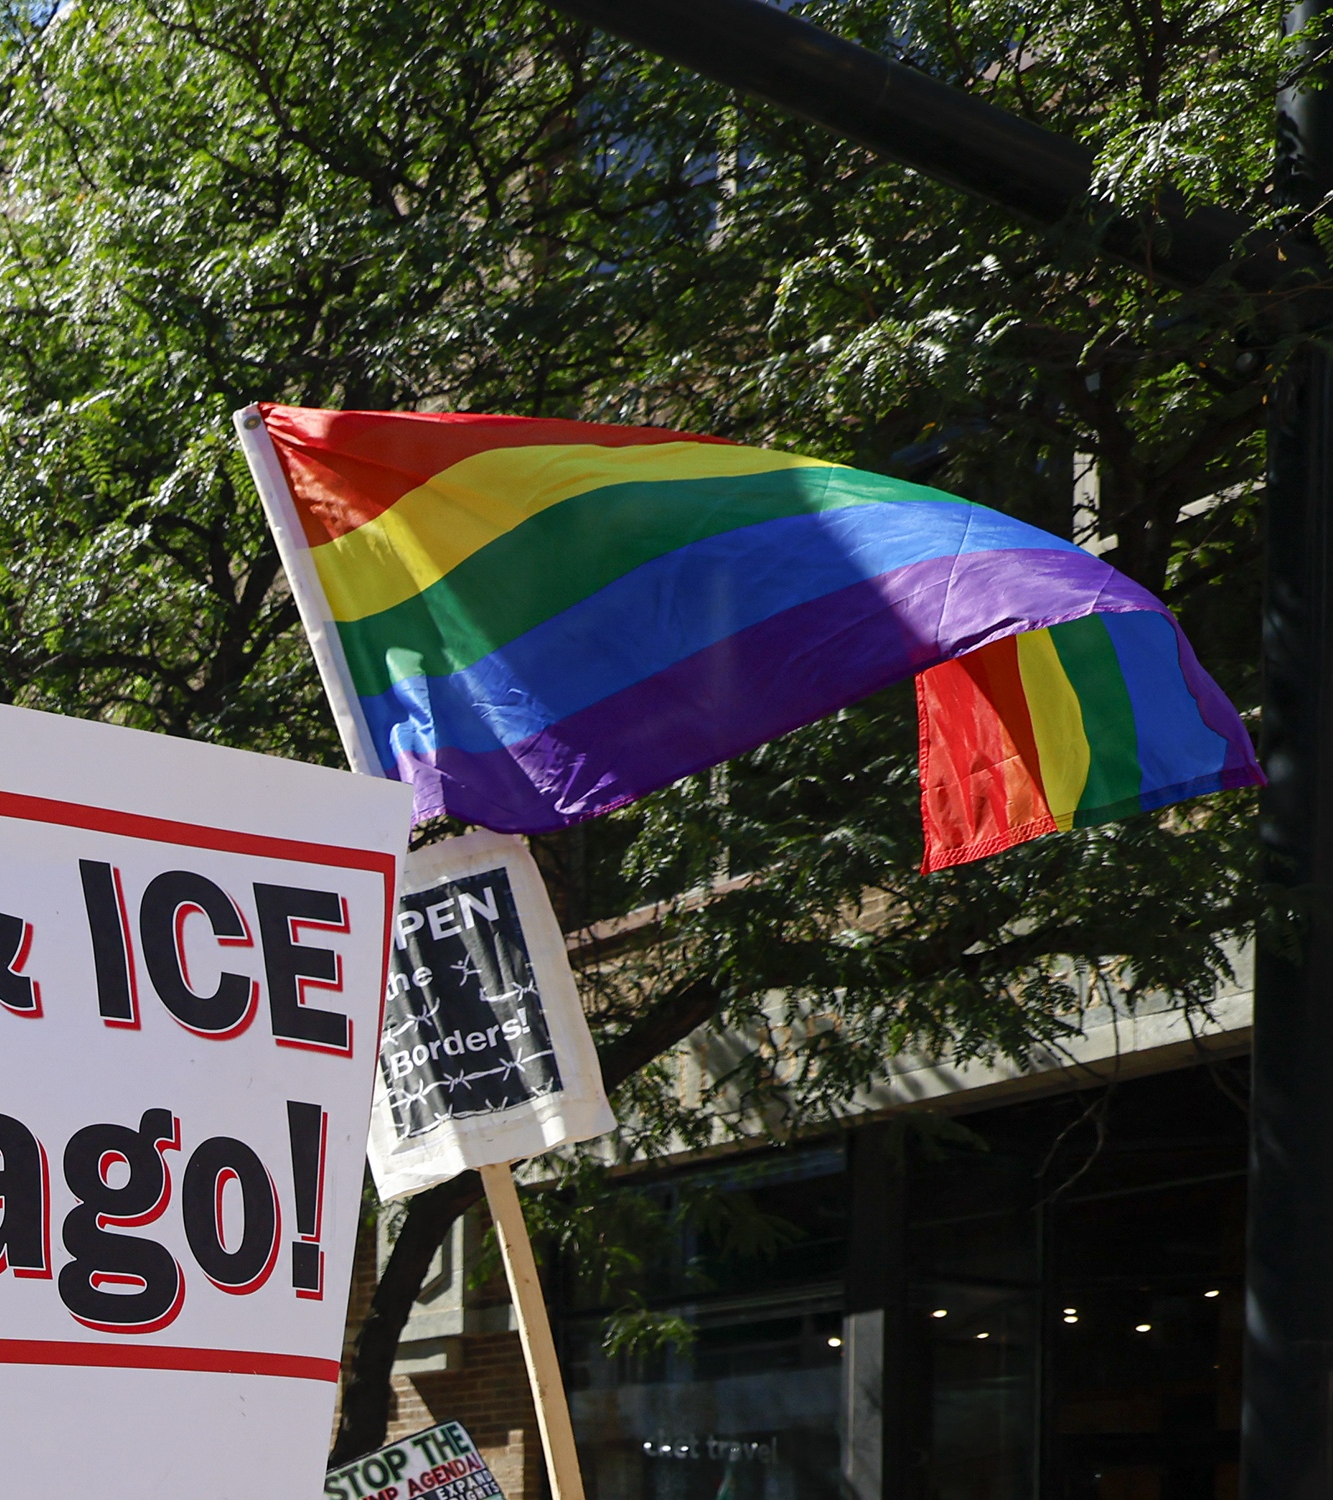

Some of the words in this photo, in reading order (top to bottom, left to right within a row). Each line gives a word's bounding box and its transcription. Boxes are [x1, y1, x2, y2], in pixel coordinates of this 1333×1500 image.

[78, 858, 353, 1060] ICE
[389, 1006, 531, 1081] Borders!
[407, 1452, 482, 1498] AGENDA!
[412, 1423, 471, 1468] THE
